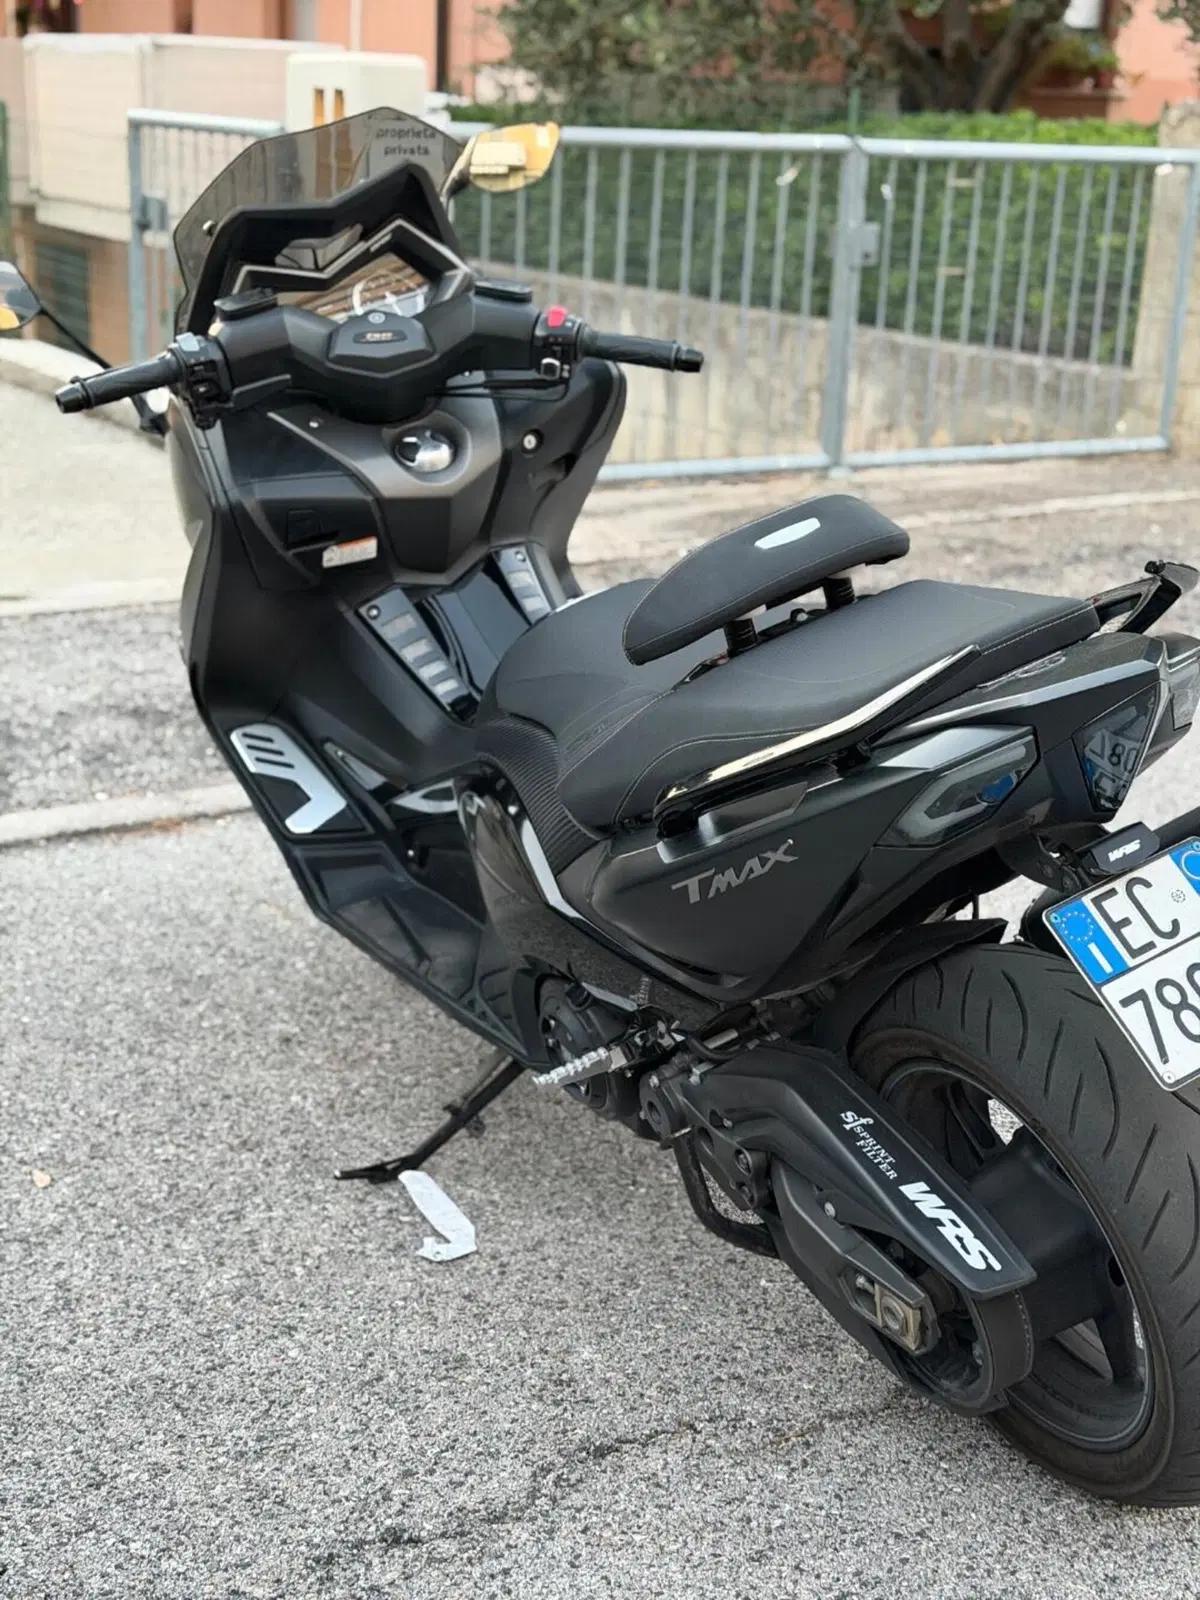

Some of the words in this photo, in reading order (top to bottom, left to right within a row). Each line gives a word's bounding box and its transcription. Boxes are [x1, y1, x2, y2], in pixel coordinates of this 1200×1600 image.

[384, 144, 430, 156] privata
[671, 838, 799, 904] TMAX
[1107, 839, 1141, 863] WRS
[1090, 876, 1181, 960] EC
[853, 1125, 896, 1163] SPRINT
[855, 1139, 898, 1180] FILTER
[898, 1181, 1002, 1272] WRS
